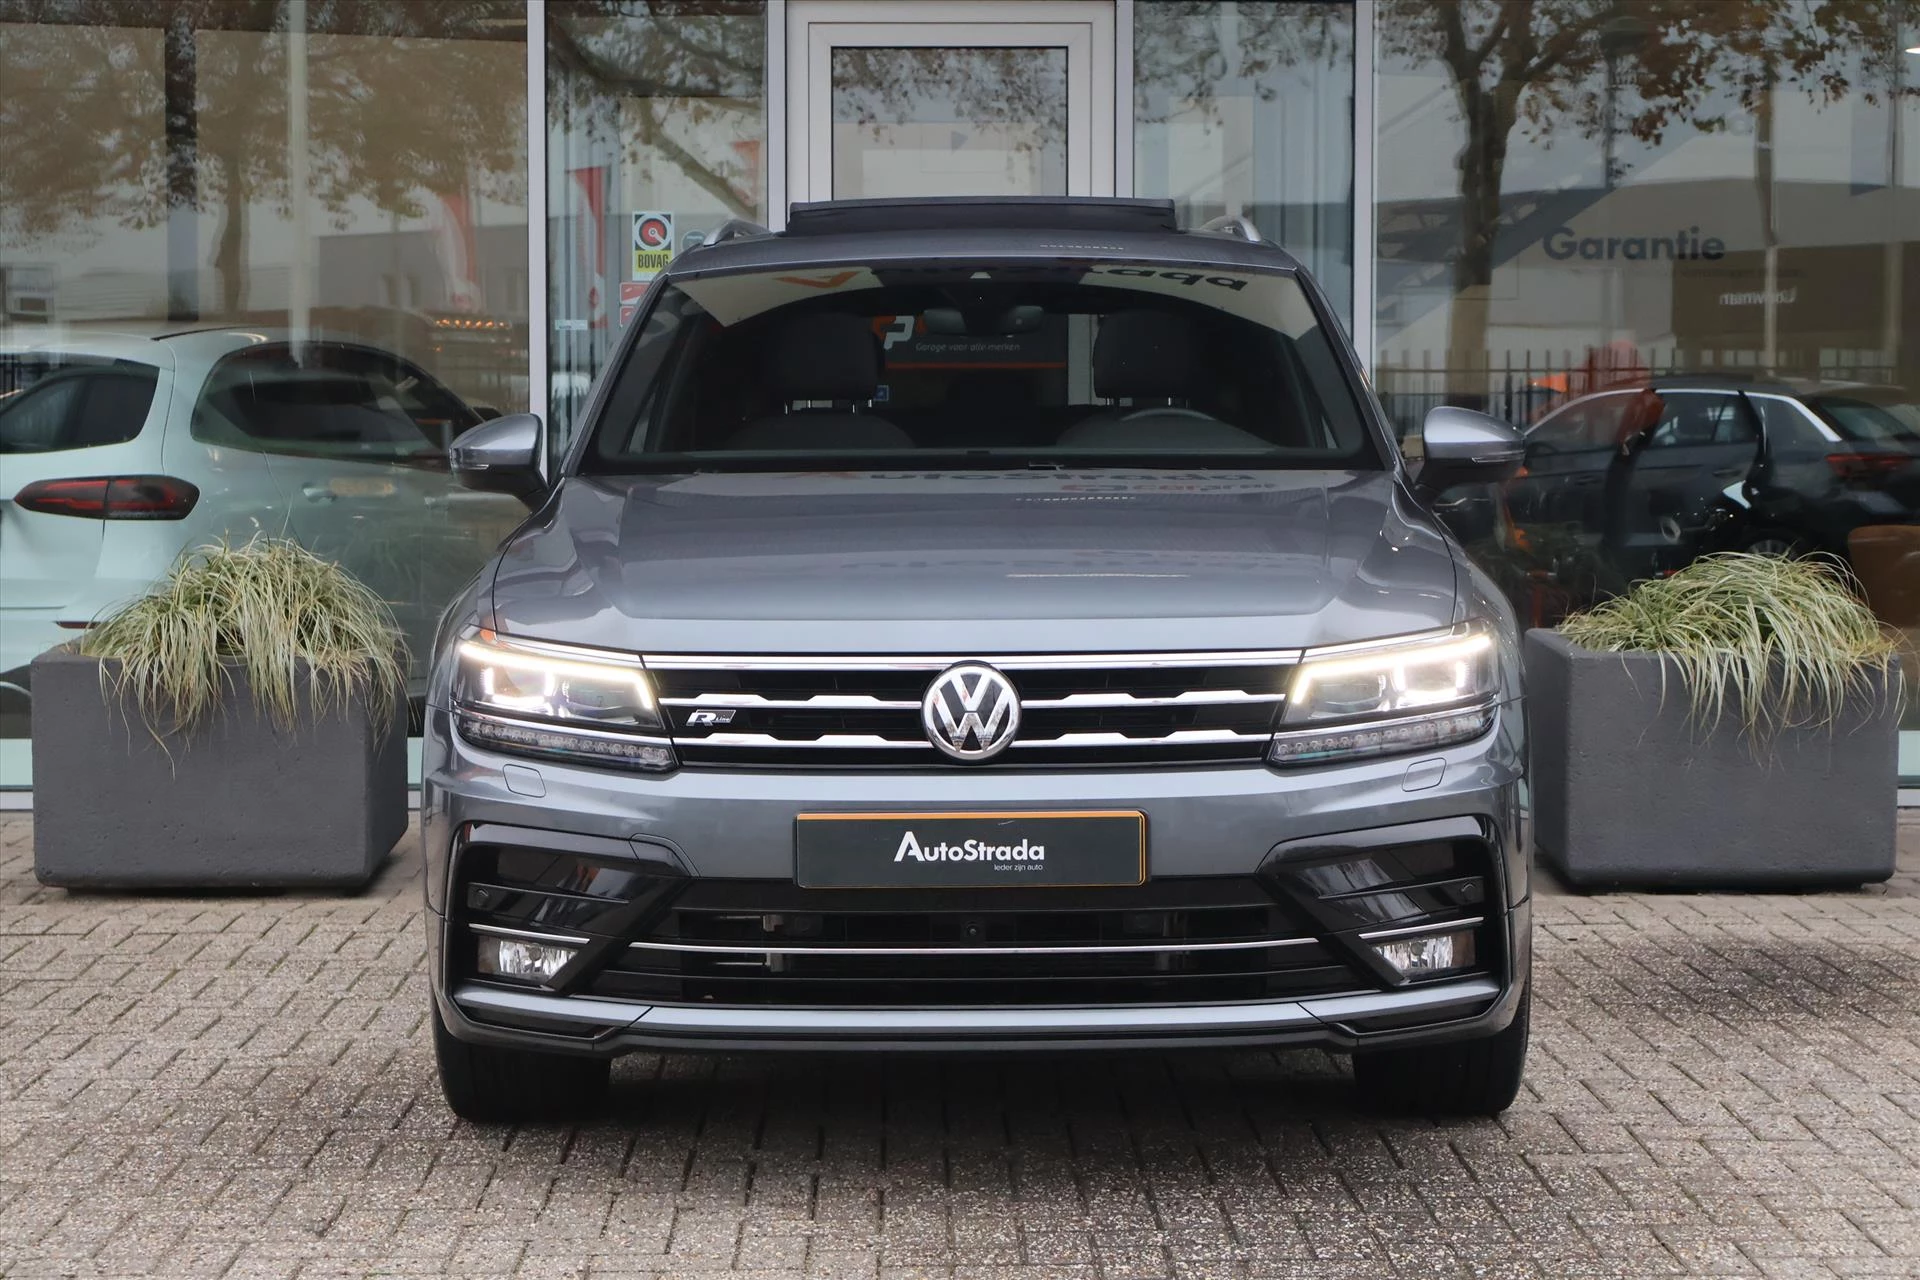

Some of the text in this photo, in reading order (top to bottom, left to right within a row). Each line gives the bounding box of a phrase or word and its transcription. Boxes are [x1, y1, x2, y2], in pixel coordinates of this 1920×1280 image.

[1542, 225, 1726, 261] Garantie
[637, 253, 670, 269] BOVAG
[915, 342, 1021, 352] Garage voor alle merken
[893, 831, 1045, 862] AutoStrada
[1014, 864, 1026, 872] zijn
